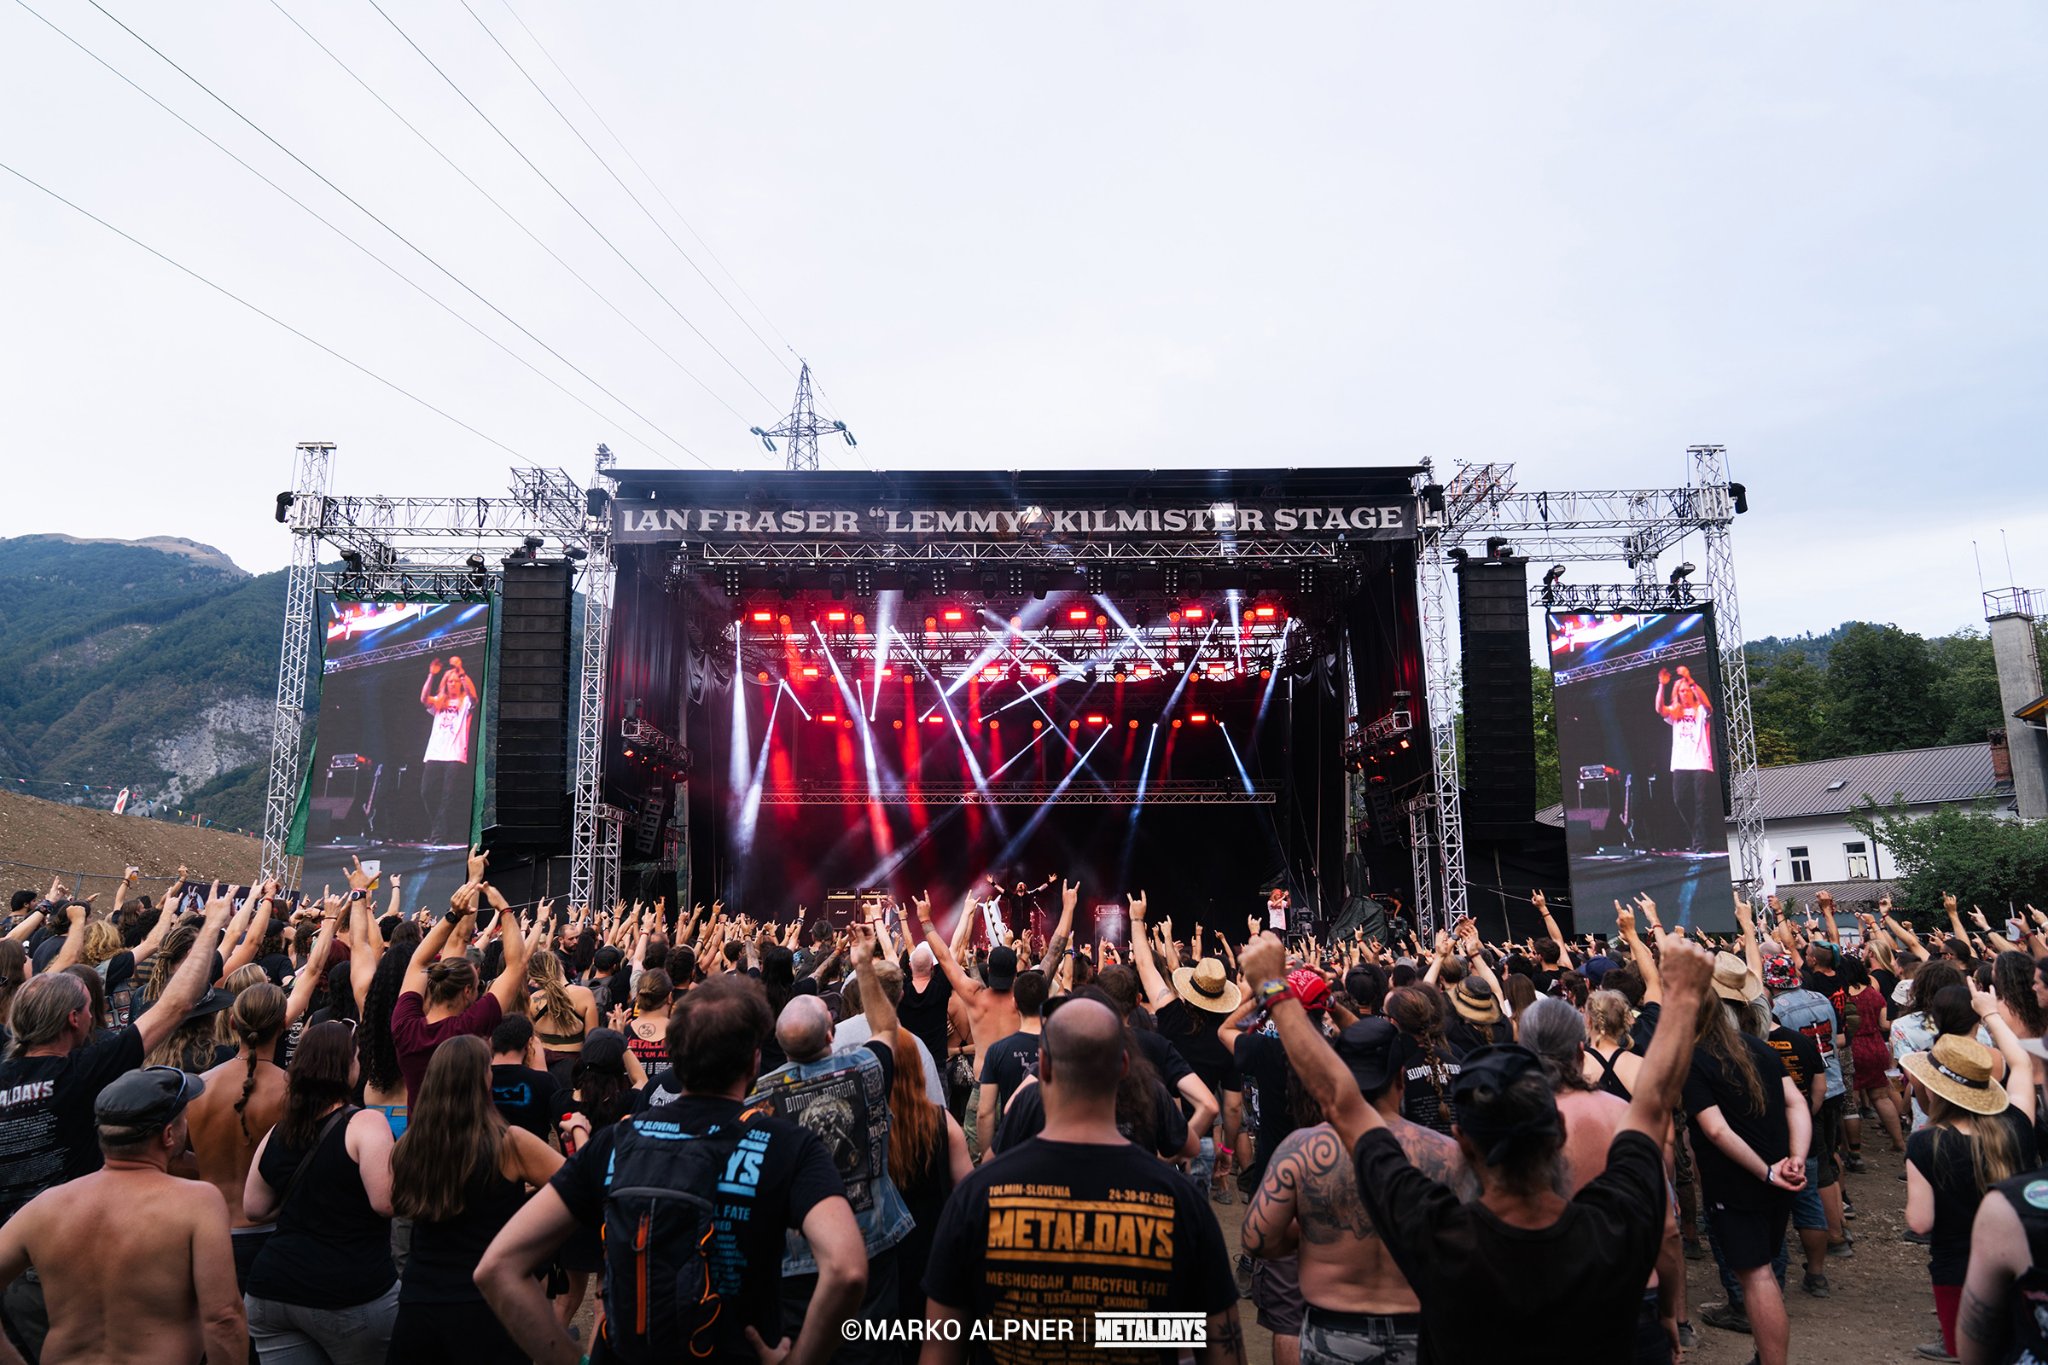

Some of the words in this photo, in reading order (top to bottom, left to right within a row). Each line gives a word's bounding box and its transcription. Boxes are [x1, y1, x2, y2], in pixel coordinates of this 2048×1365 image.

[622, 509, 692, 532] IAN
[699, 509, 860, 533] FRASER
[1051, 508, 1266, 532] KILMISTER
[1273, 506, 1403, 531] STAGE
[718, 1150, 765, 1186] YS
[723, 1204, 751, 1221] FATE
[986, 1209, 1175, 1259] METALDAYS
[985, 1271, 1065, 1291] MESHUGGAH
[1071, 1275, 1140, 1296] MERCYFUL
[1142, 1280, 1169, 1297] FATE
